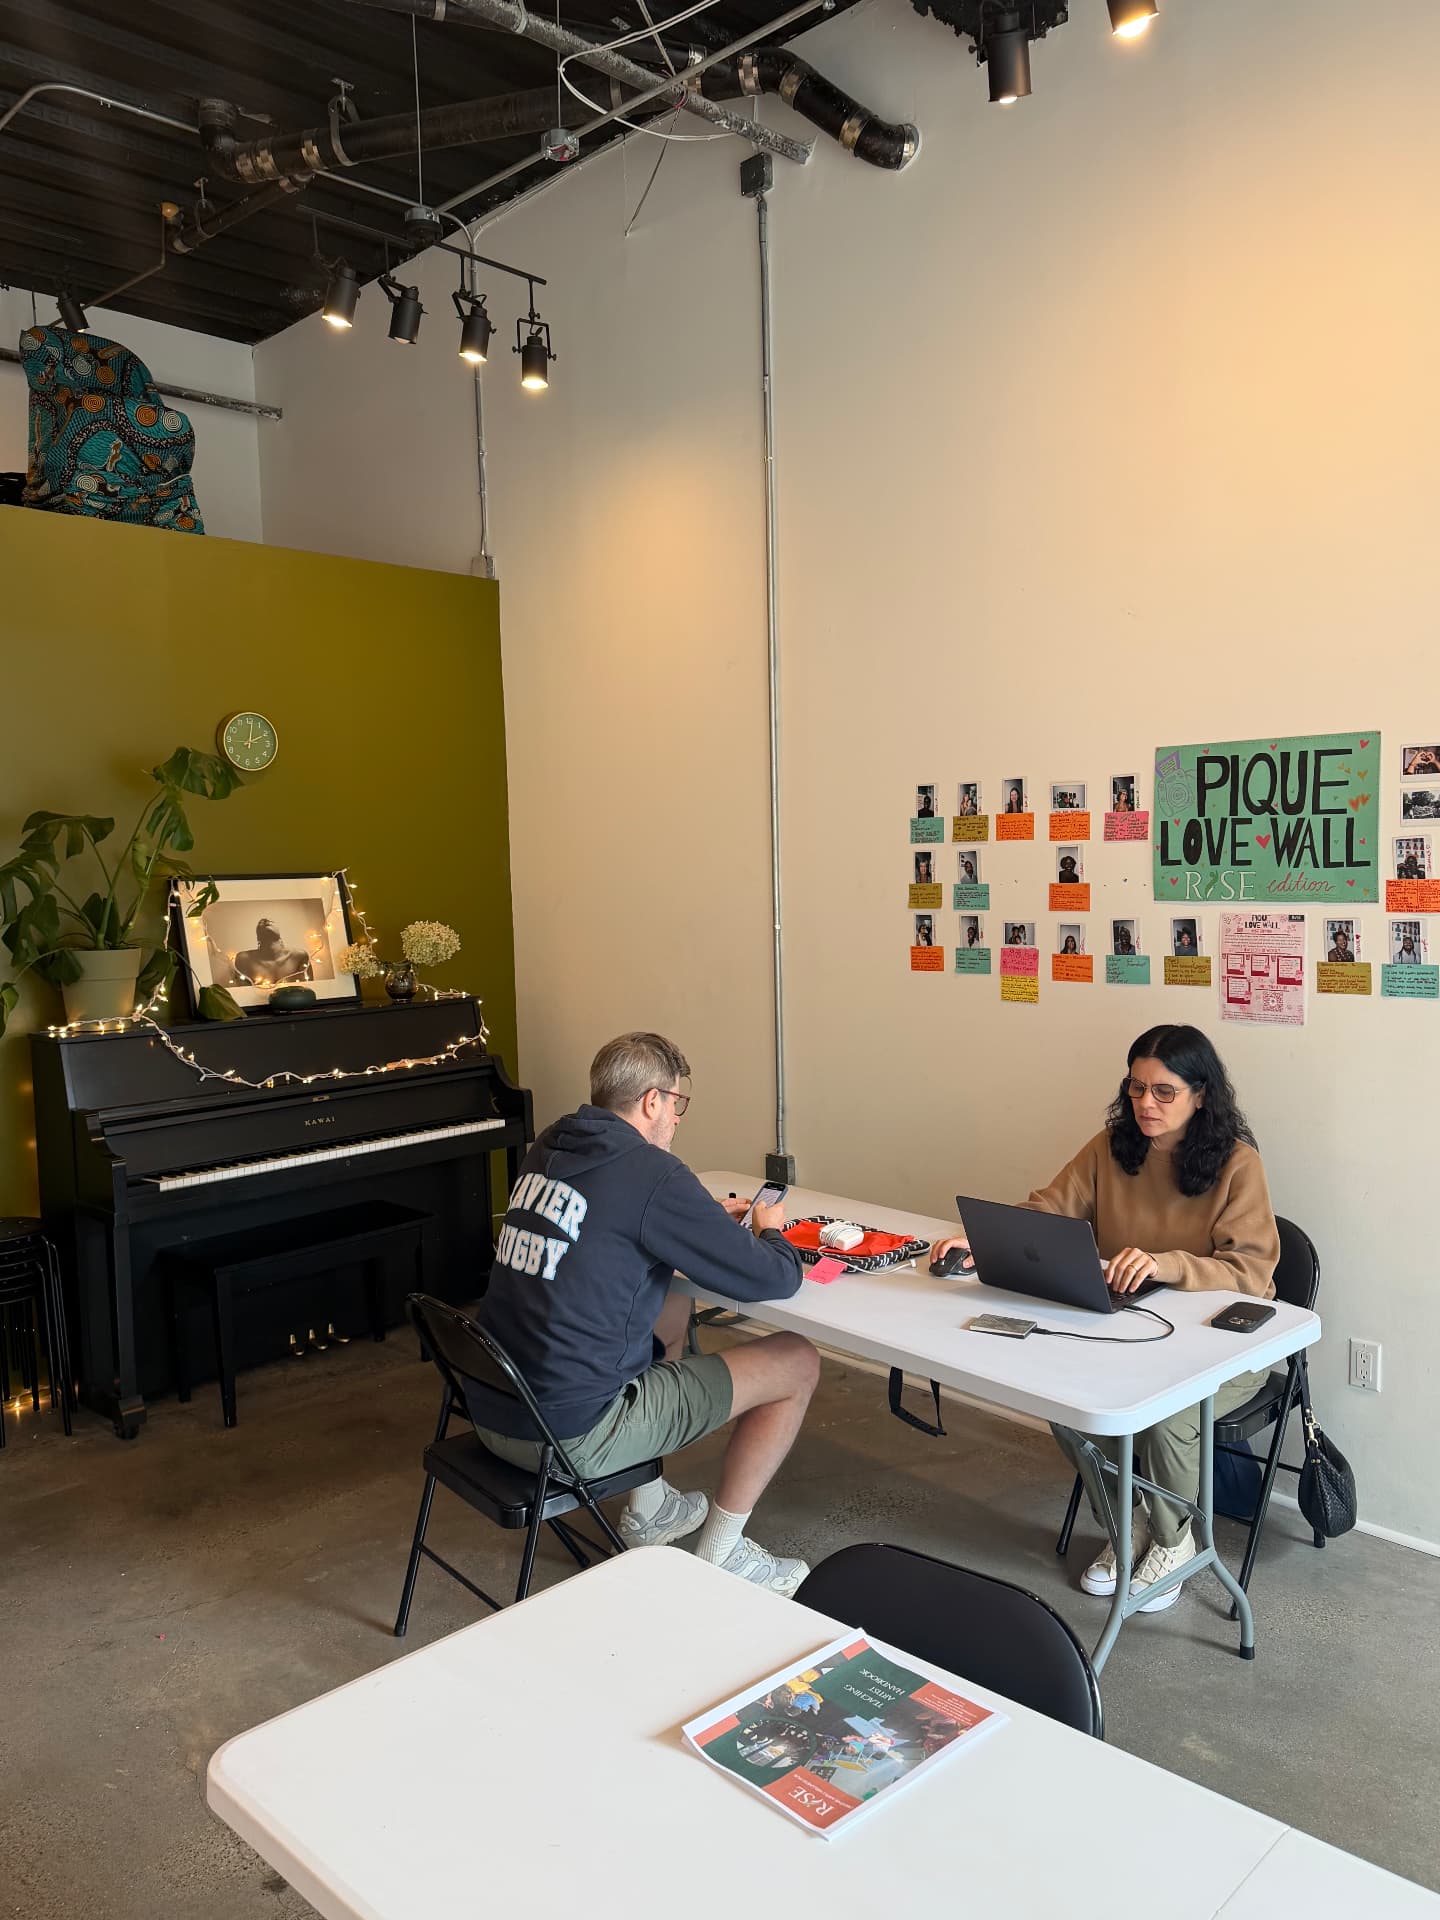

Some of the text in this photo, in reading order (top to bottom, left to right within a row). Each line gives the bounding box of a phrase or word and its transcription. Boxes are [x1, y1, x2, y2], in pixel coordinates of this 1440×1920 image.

[230, 726, 237, 734] 10
[226, 735, 232, 743] 9
[265, 740, 270, 748] 3
[235, 754, 241, 762] 7
[255, 756, 261, 764] 5
[1196, 749, 1353, 817] PIQUE
[1160, 817, 1253, 867] LOVE
[1270, 817, 1371, 868] WALL
[1266, 872, 1336, 894] edition
[1244, 921, 1261, 929] LOVE
[304, 1116, 335, 1126] KAWAI
[507, 1172, 588, 1241] AVIER
[859, 1668, 906, 1696] HANDBOOK
[843, 1684, 884, 1709] TEACHING
[868, 1686, 896, 1701] ARTIST
